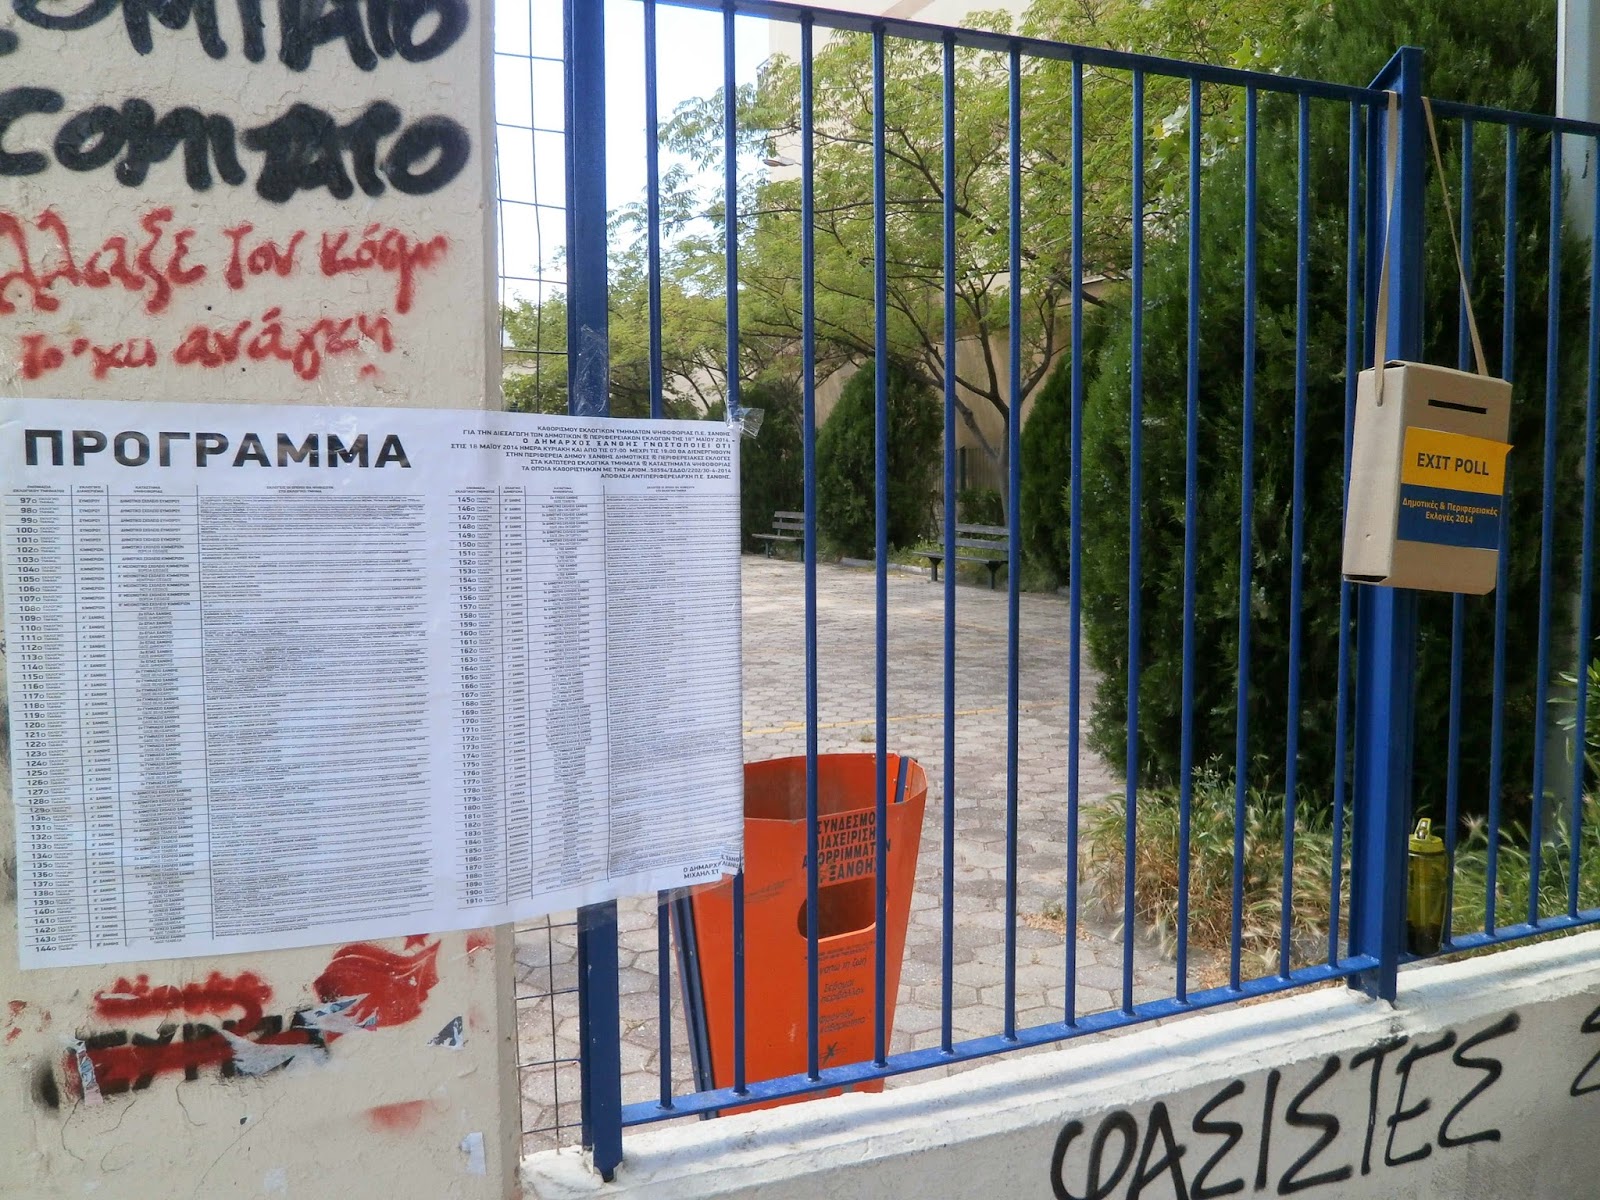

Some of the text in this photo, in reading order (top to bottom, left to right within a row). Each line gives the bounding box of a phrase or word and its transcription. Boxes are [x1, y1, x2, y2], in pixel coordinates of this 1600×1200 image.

[222, 220, 306, 290] τον
[24, 429, 412, 468] ΠΡΟΓΡΑΜΜΑ
[1417, 452, 1489, 476] EXIT POLL
[1402, 498, 1498, 516] Δημοτικές & Περιφερειακές
[1426, 511, 1474, 524] Εκλογές 2014
[829, 857, 876, 882] ΞΑΝΘΗ
[1050, 1012, 1521, 1200] ΦΑΣΙΣΤΕΣ
